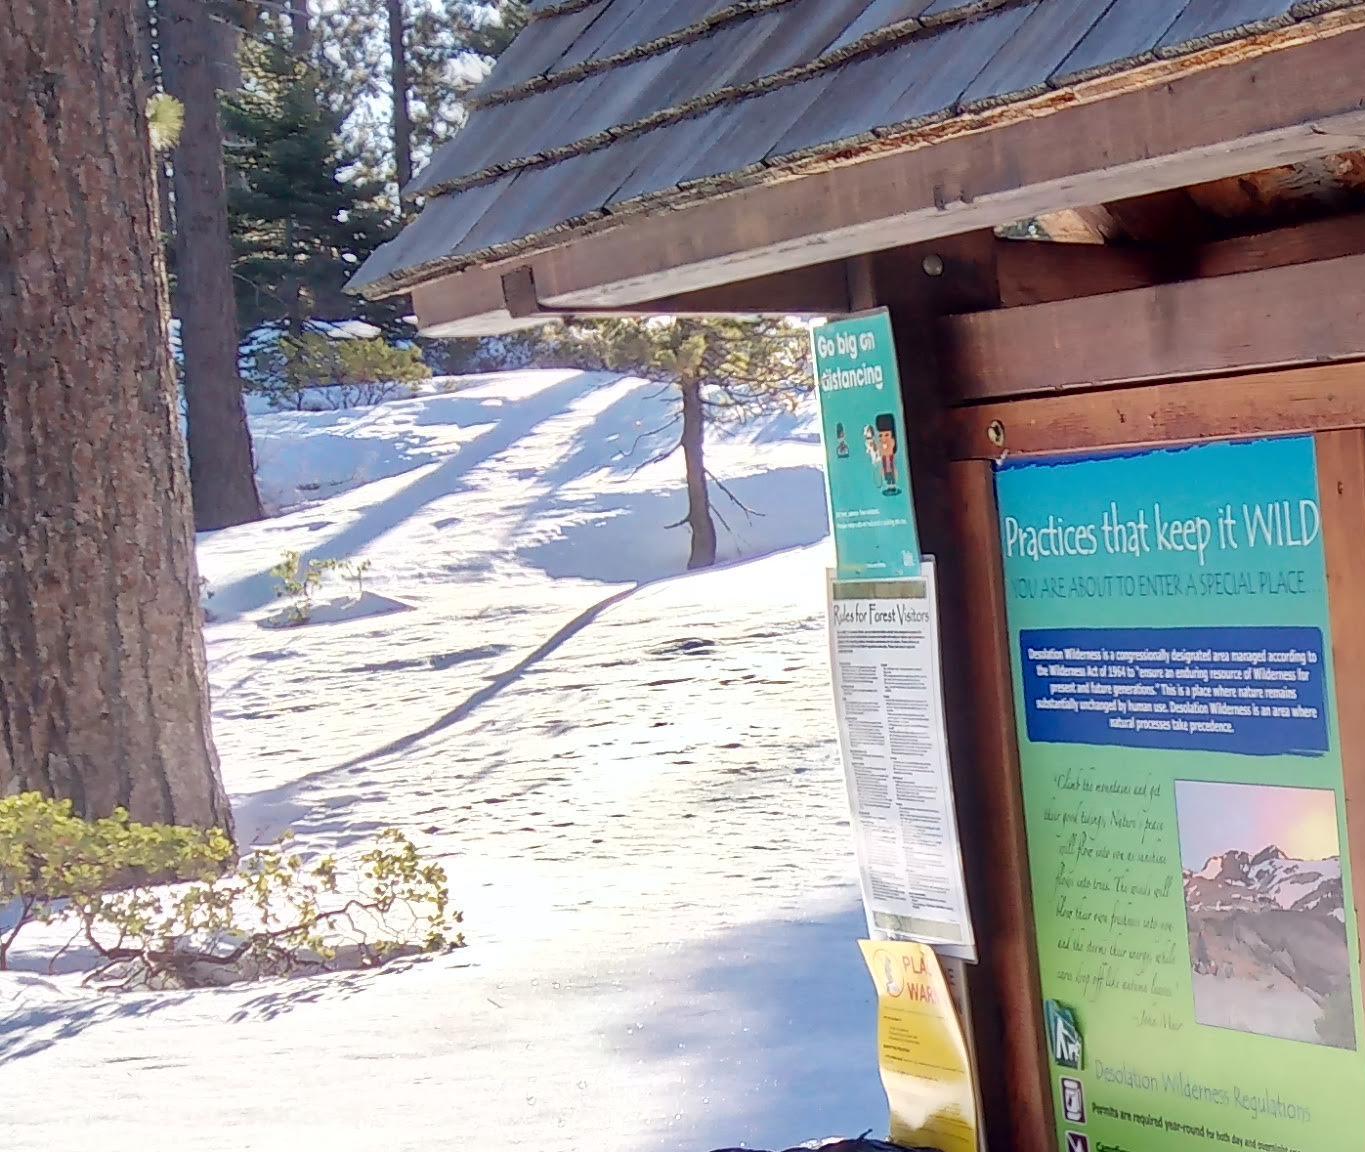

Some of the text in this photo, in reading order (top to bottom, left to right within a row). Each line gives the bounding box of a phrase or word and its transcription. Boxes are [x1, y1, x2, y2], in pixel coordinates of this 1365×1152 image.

[817, 331, 876, 359] Go big on
[821, 363, 884, 392] distancing
[1003, 499, 1321, 567] Practices that keep it WILD
[833, 603, 930, 626] Rules for Forest Visitors
